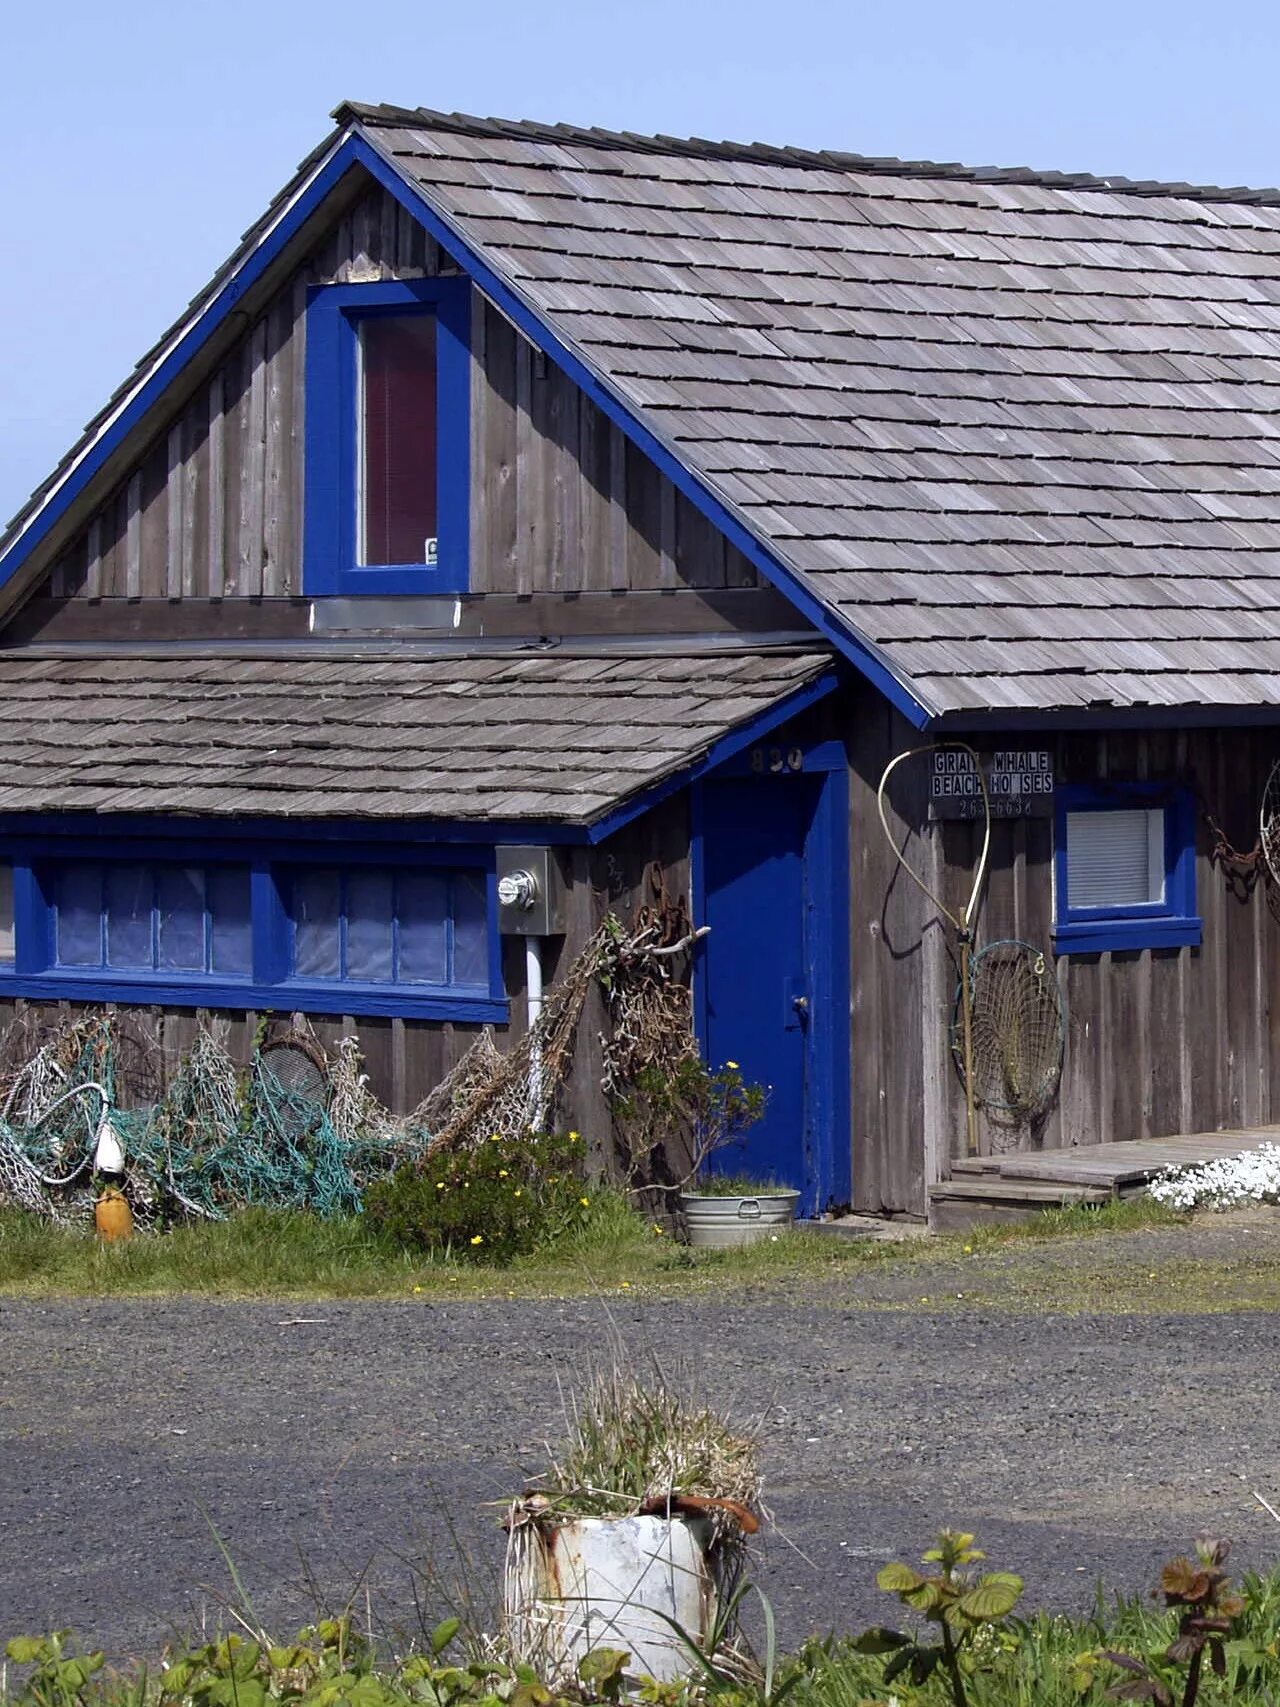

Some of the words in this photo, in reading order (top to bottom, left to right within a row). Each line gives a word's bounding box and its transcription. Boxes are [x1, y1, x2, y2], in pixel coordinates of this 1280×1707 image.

[751, 747, 803, 773] 830
[995, 752, 1048, 772] WHALE
[933, 775, 984, 796] BEACH
[991, 774, 1053, 793] HOSES
